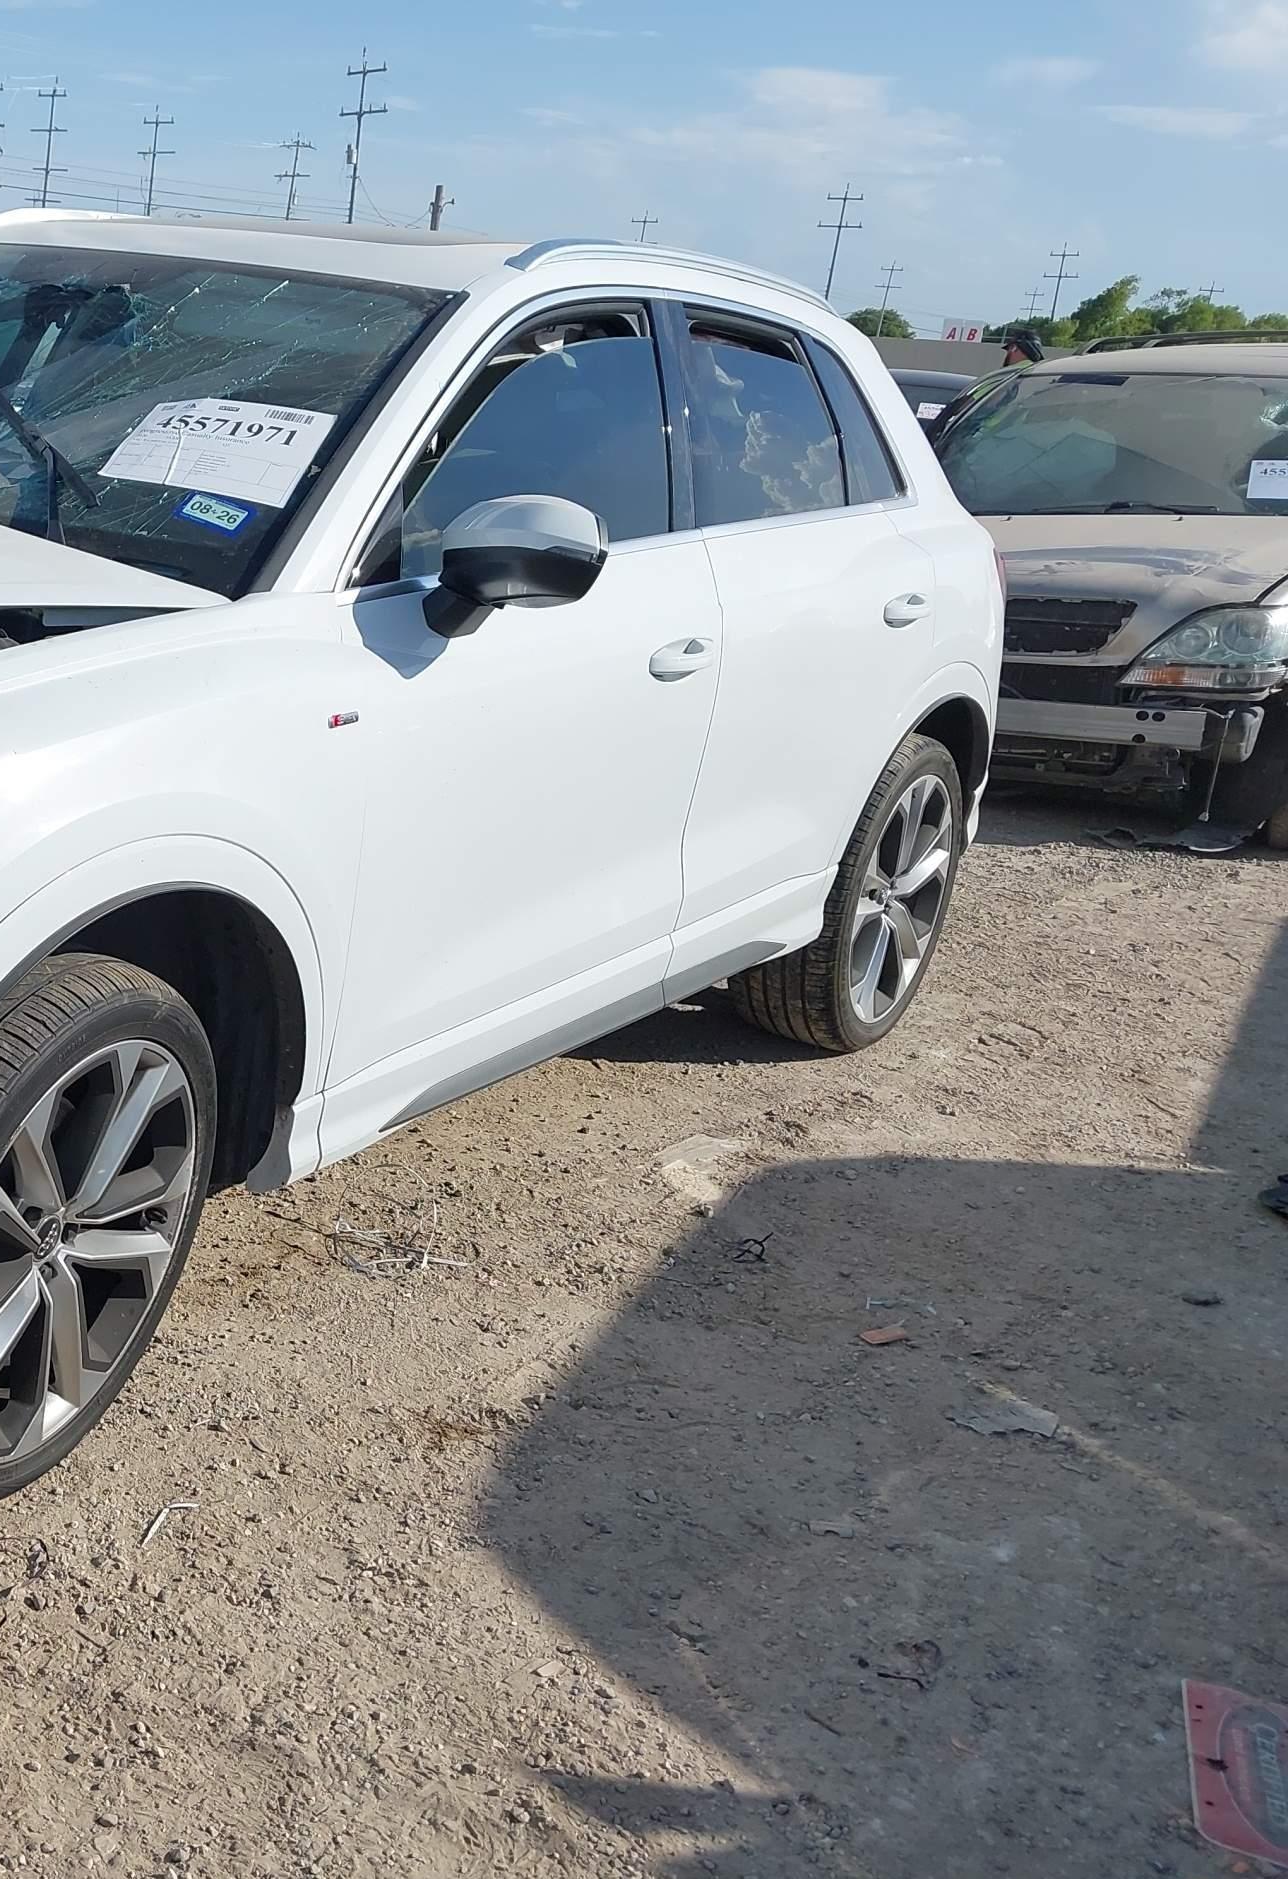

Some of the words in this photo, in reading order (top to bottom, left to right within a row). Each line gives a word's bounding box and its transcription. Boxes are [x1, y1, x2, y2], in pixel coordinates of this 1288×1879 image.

[946, 327, 957, 340] A
[967, 328, 978, 341] B
[156, 414, 298, 447] 45571971
